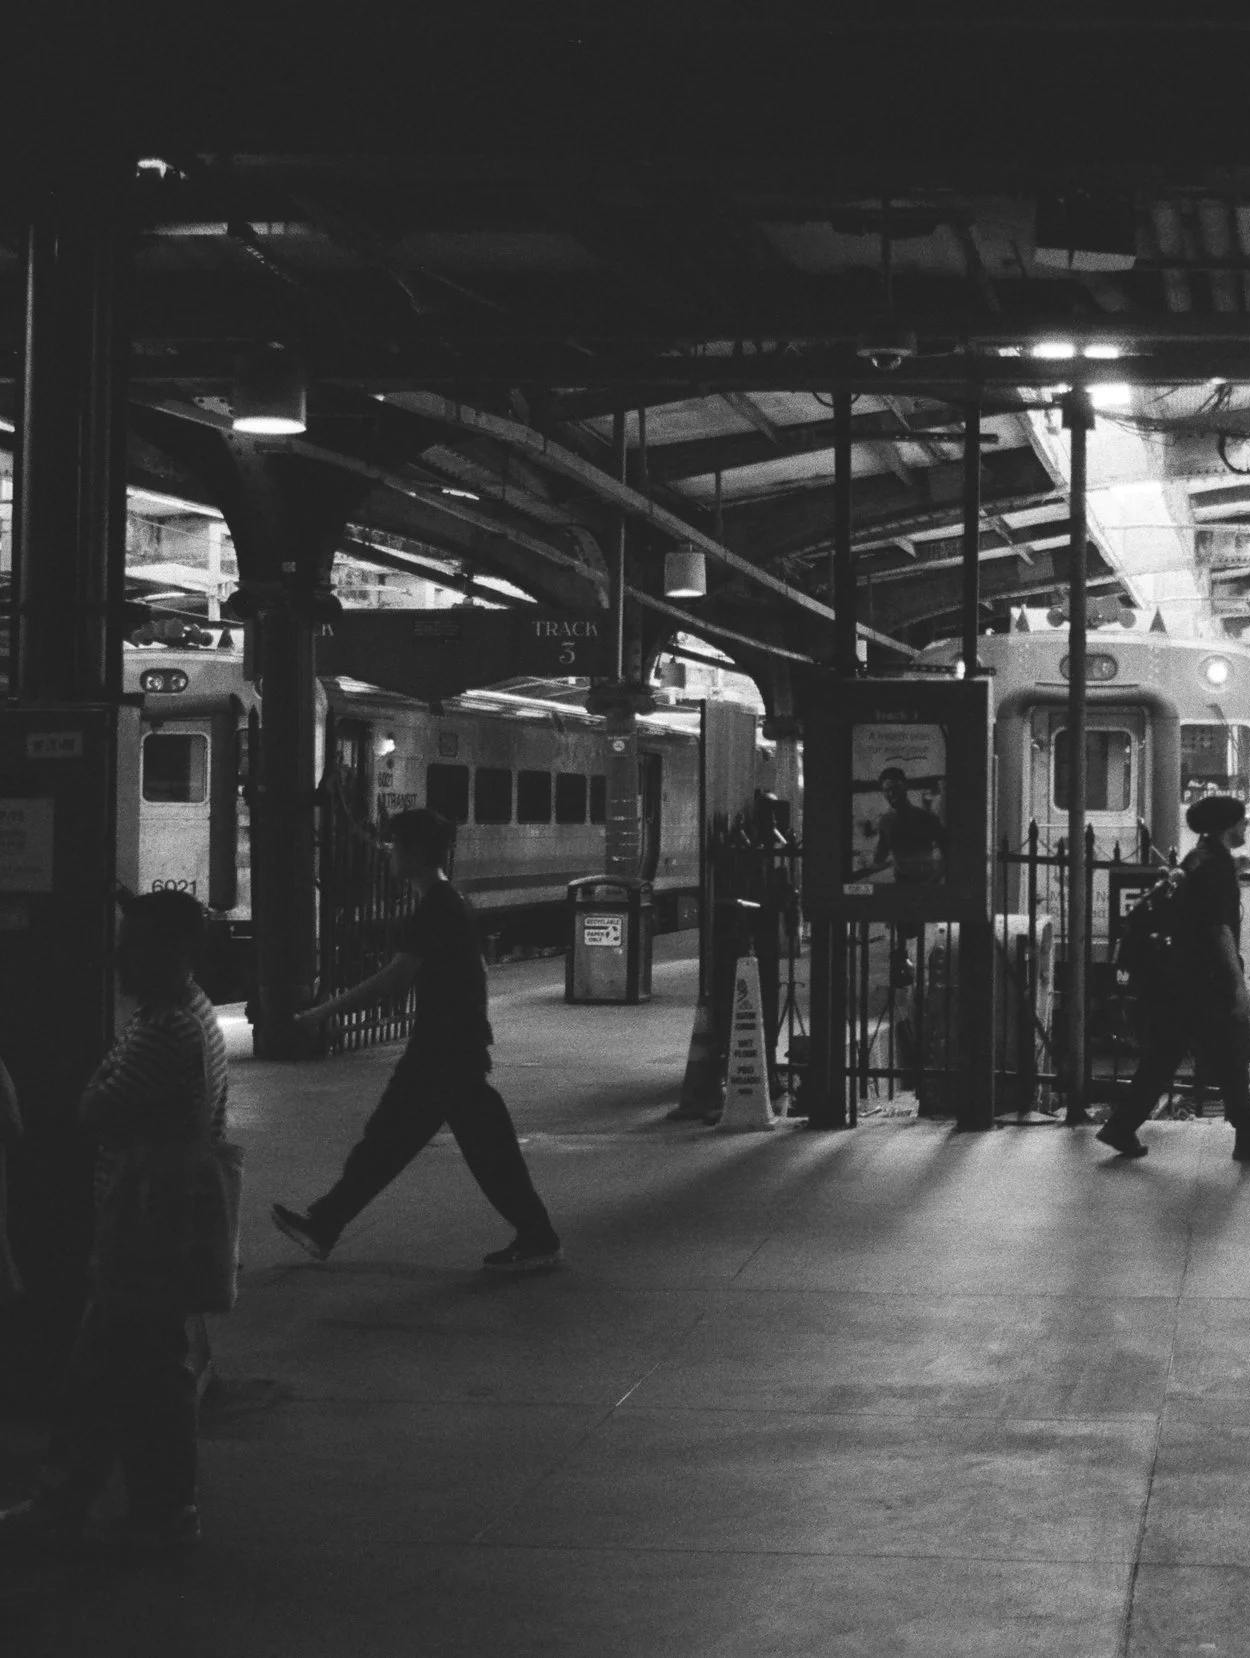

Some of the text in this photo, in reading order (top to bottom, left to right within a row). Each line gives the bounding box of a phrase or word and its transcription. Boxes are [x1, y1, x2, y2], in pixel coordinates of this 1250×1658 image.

[532, 620, 600, 638] TRACK
[558, 641, 577, 665] 3
[152, 879, 196, 896] 6021
